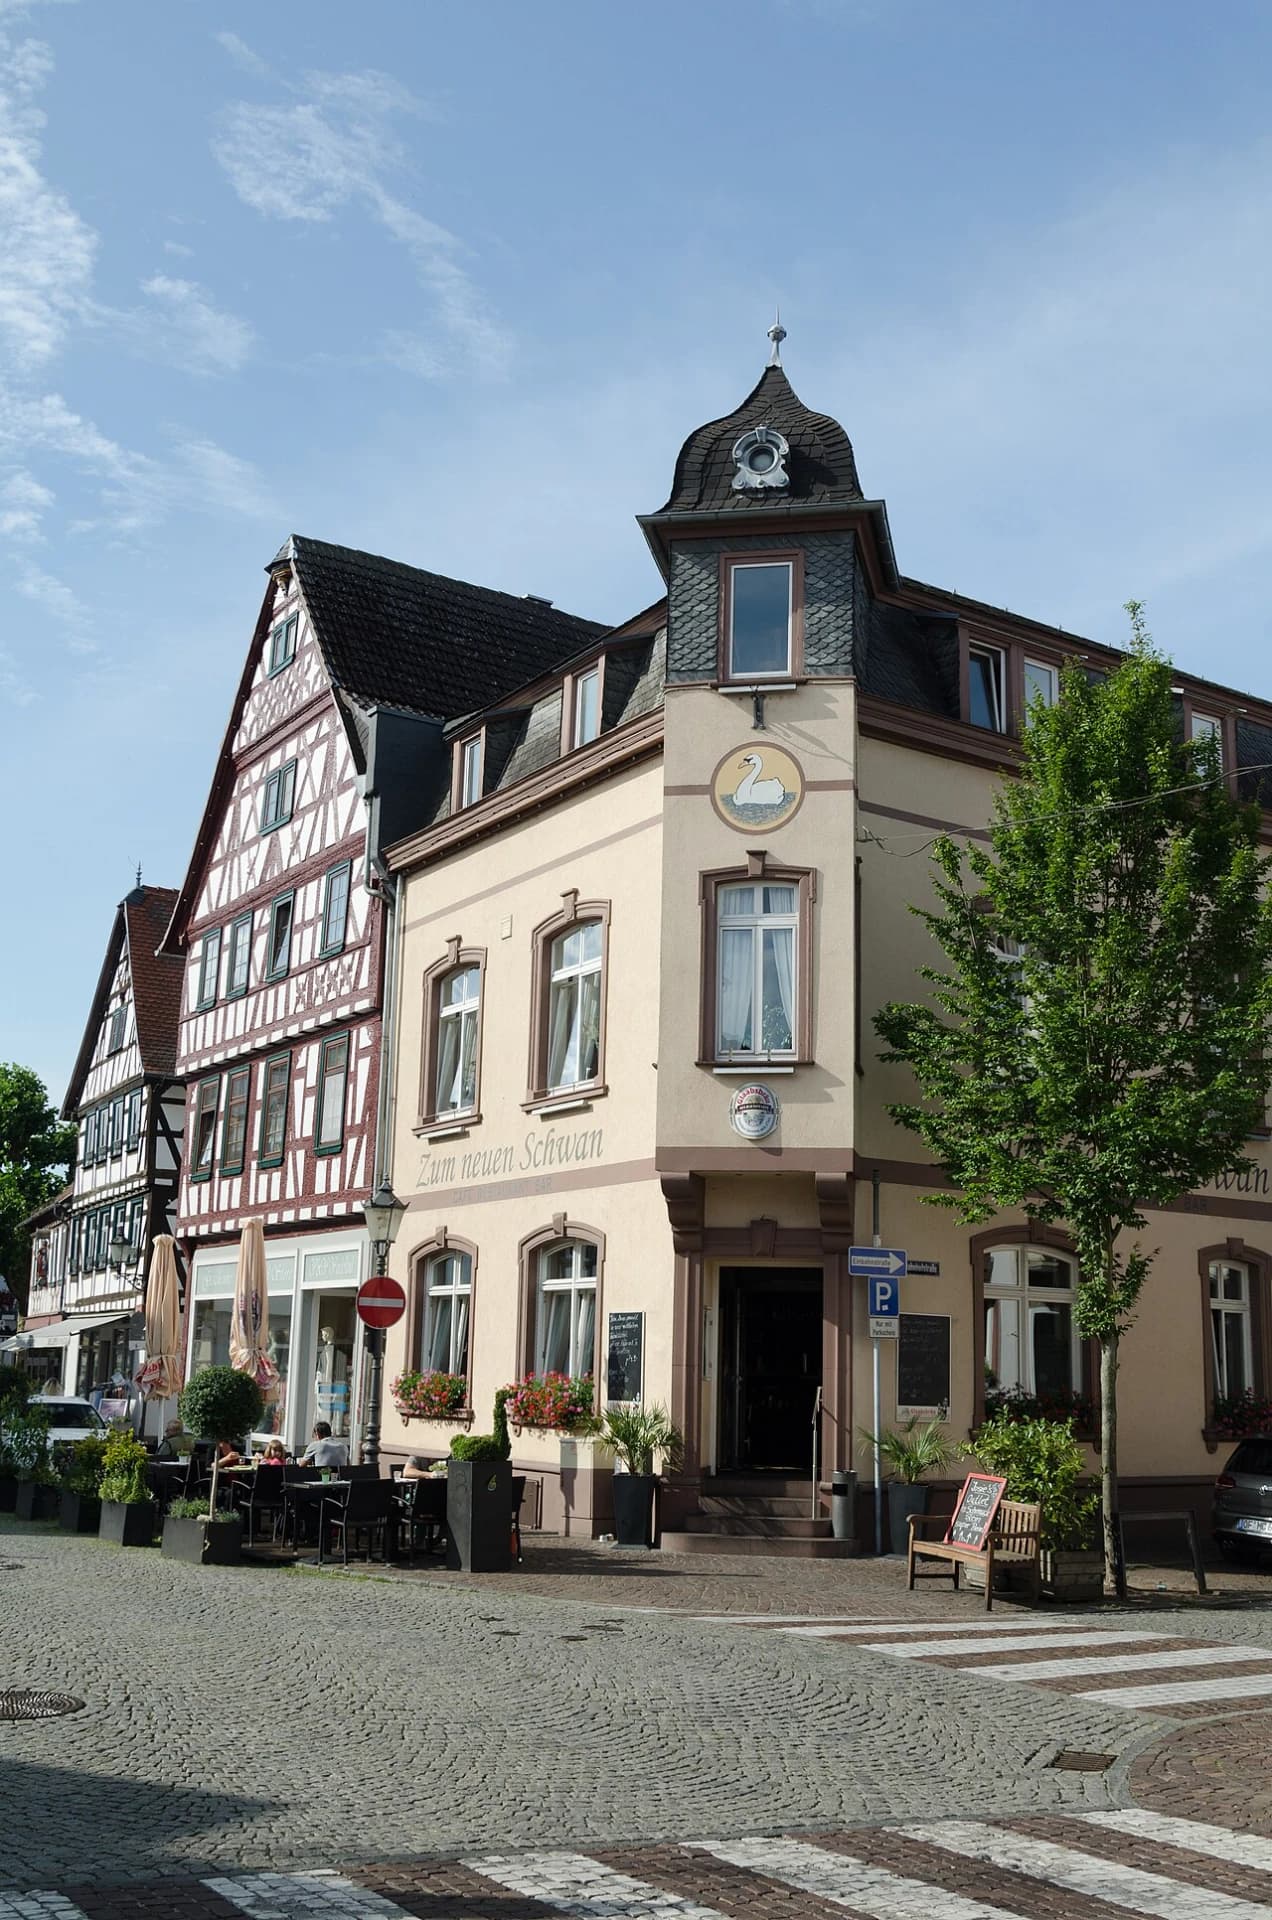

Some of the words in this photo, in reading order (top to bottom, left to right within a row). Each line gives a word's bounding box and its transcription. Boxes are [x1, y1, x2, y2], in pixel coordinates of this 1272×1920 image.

[416, 1153, 455, 1188] Zum
[461, 1145, 515, 1180] neuen
[519, 1127, 604, 1171] Schwan
[535, 1176, 553, 1192] BAR
[876, 1282, 892, 1311] P
[966, 1494, 990, 1506] Outlet
